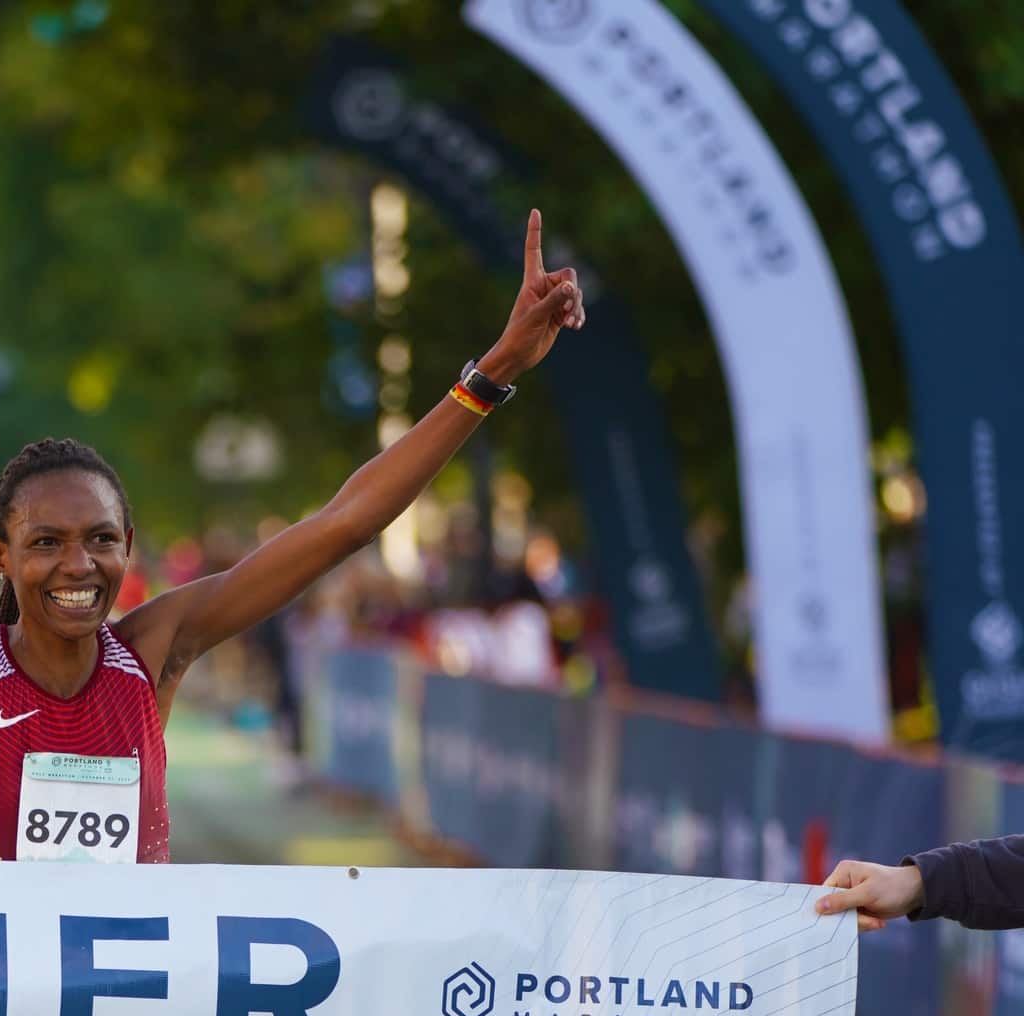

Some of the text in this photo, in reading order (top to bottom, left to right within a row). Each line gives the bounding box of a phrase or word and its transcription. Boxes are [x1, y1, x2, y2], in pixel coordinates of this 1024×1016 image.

[801, 0, 988, 250] ORTLAND
[25, 808, 130, 848] 8789
[515, 972, 754, 1010] PORTLAND
